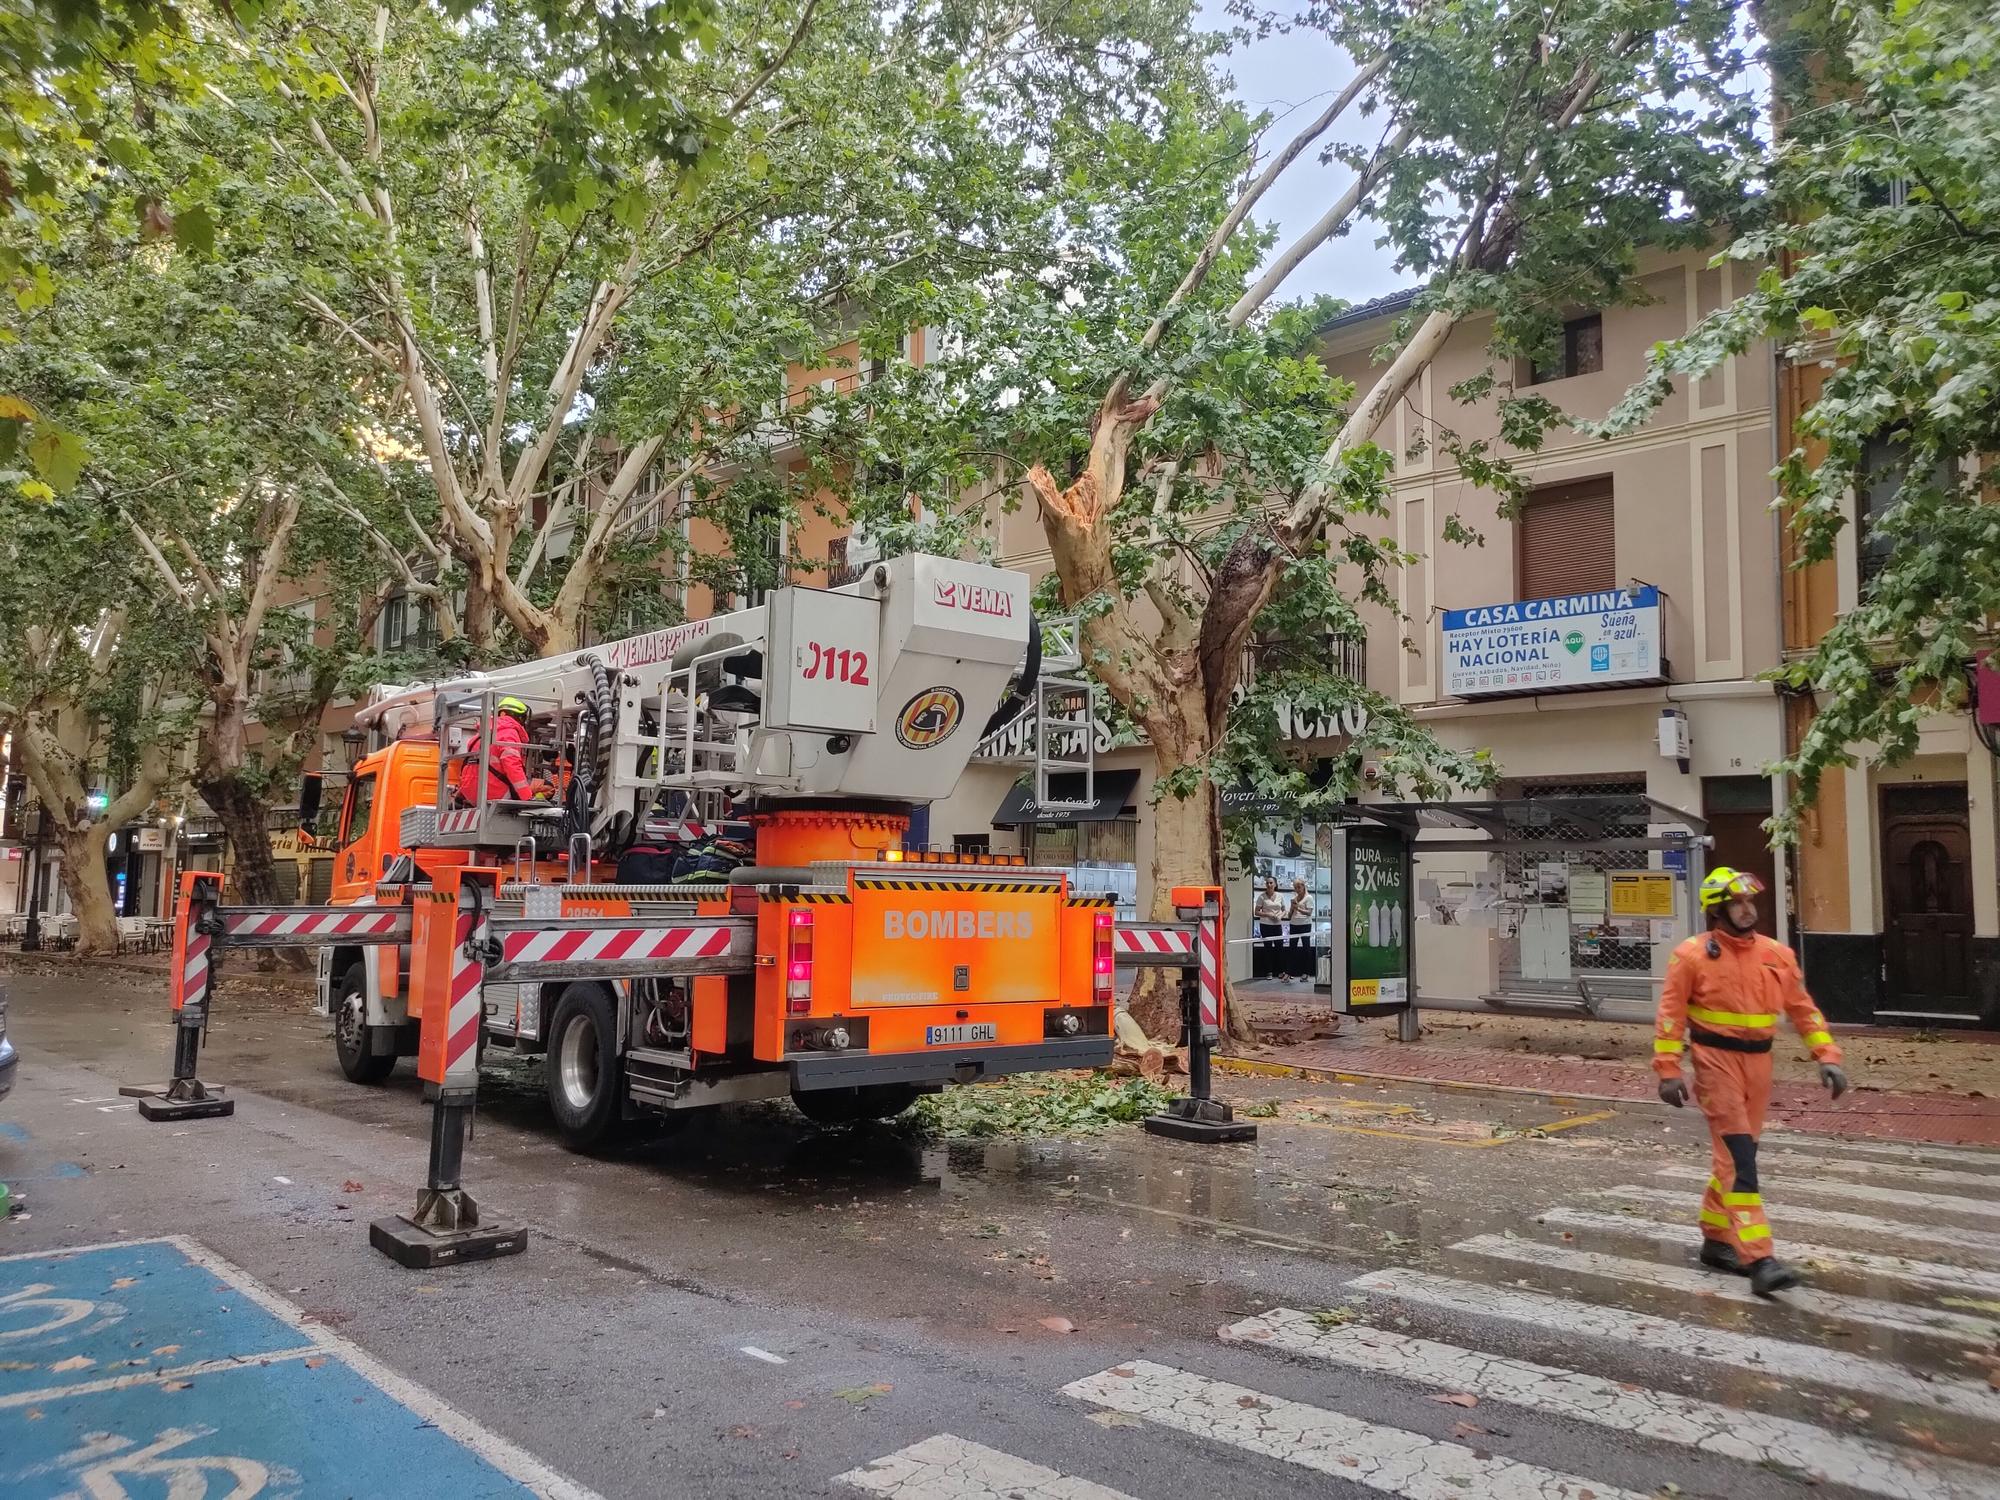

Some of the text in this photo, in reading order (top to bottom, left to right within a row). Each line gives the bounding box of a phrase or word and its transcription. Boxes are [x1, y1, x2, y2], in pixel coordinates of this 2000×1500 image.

[957, 583, 1012, 617] VEMA
[1464, 591, 1633, 626] CASA CARMINA
[1449, 627, 1561, 654] HAY LOTERÍA
[1613, 623, 1637, 640] azul
[822, 646, 869, 687] 112
[1459, 647, 1550, 668] NACIONAL
[1729, 758, 1742, 768] 16
[1355, 847, 1382, 863] DURA
[1354, 863, 1400, 891] 3X MÁS
[884, 910, 1034, 939] BOMBERS
[1351, 986, 1377, 997] GRATIS
[934, 1025, 994, 1042] 9111 GHL
